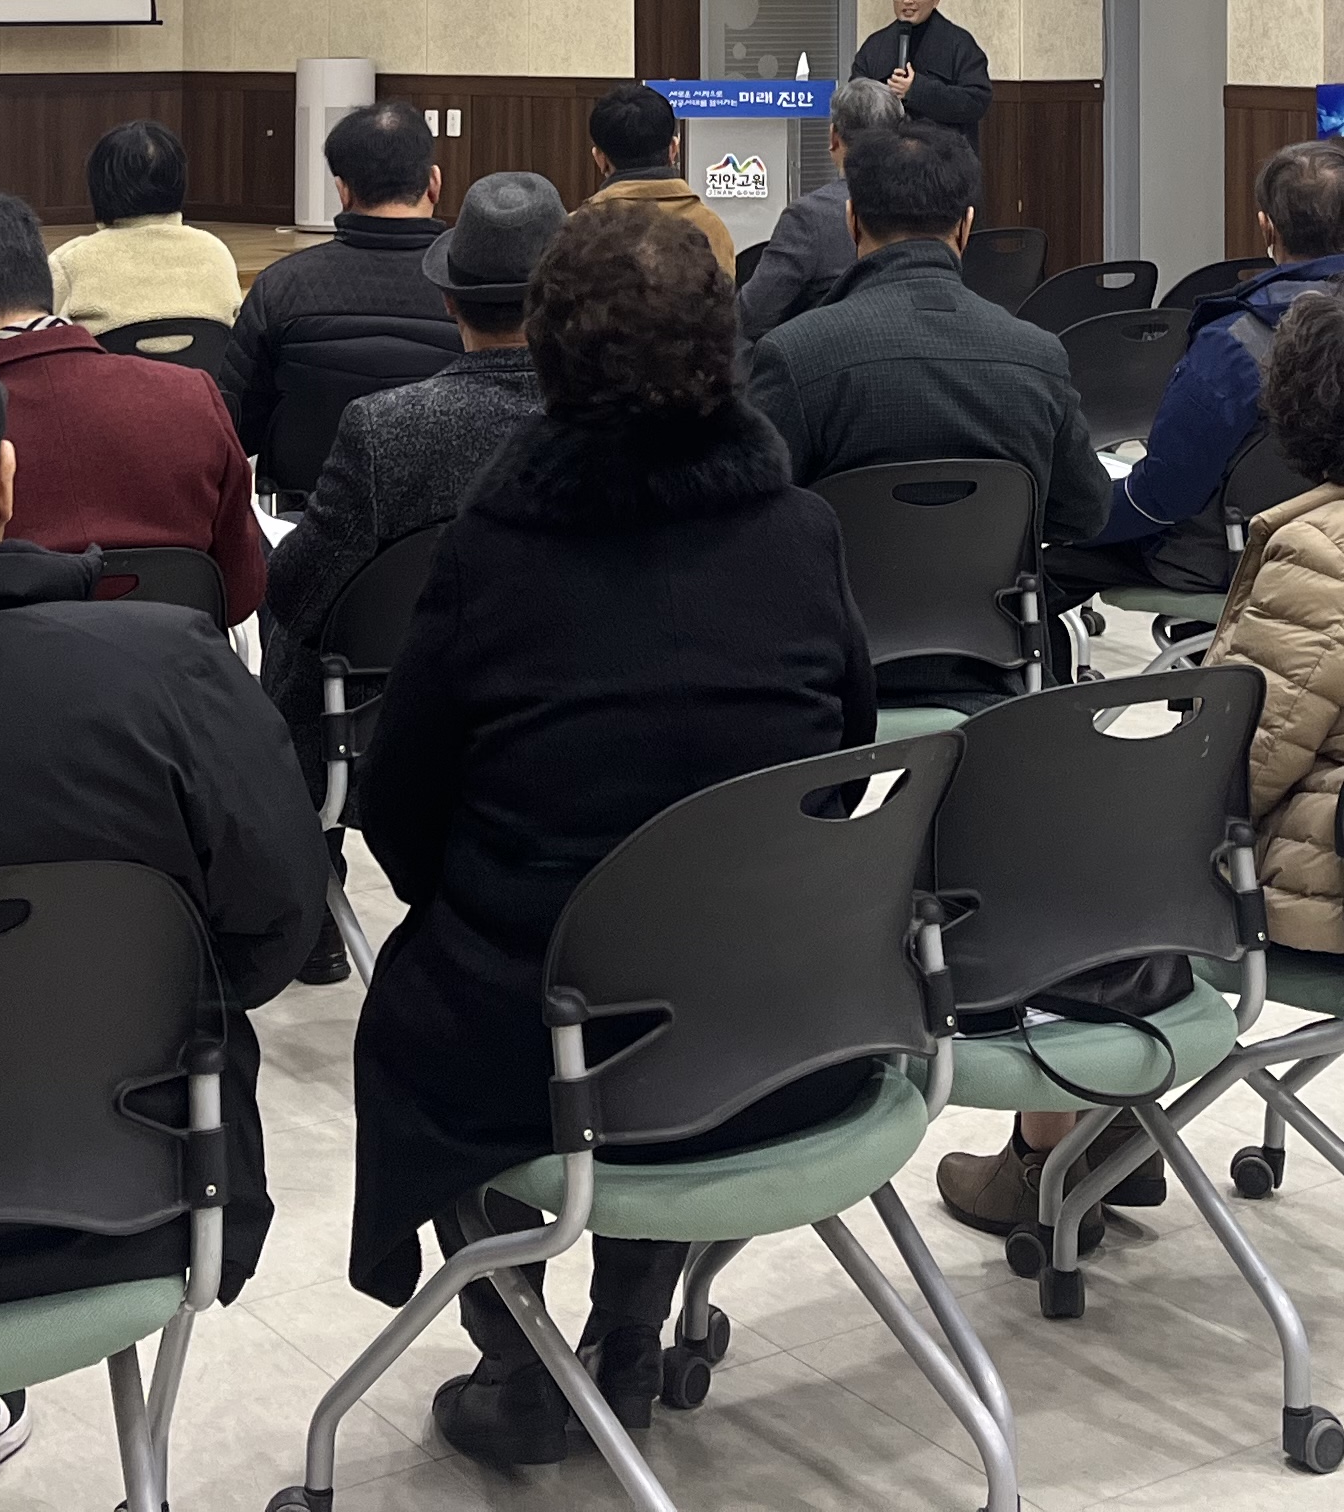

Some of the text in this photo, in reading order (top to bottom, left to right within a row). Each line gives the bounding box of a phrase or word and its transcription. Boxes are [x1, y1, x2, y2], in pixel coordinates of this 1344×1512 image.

[738, 91, 814, 108] 미래 진안
[708, 173, 766, 190] 진안고원
